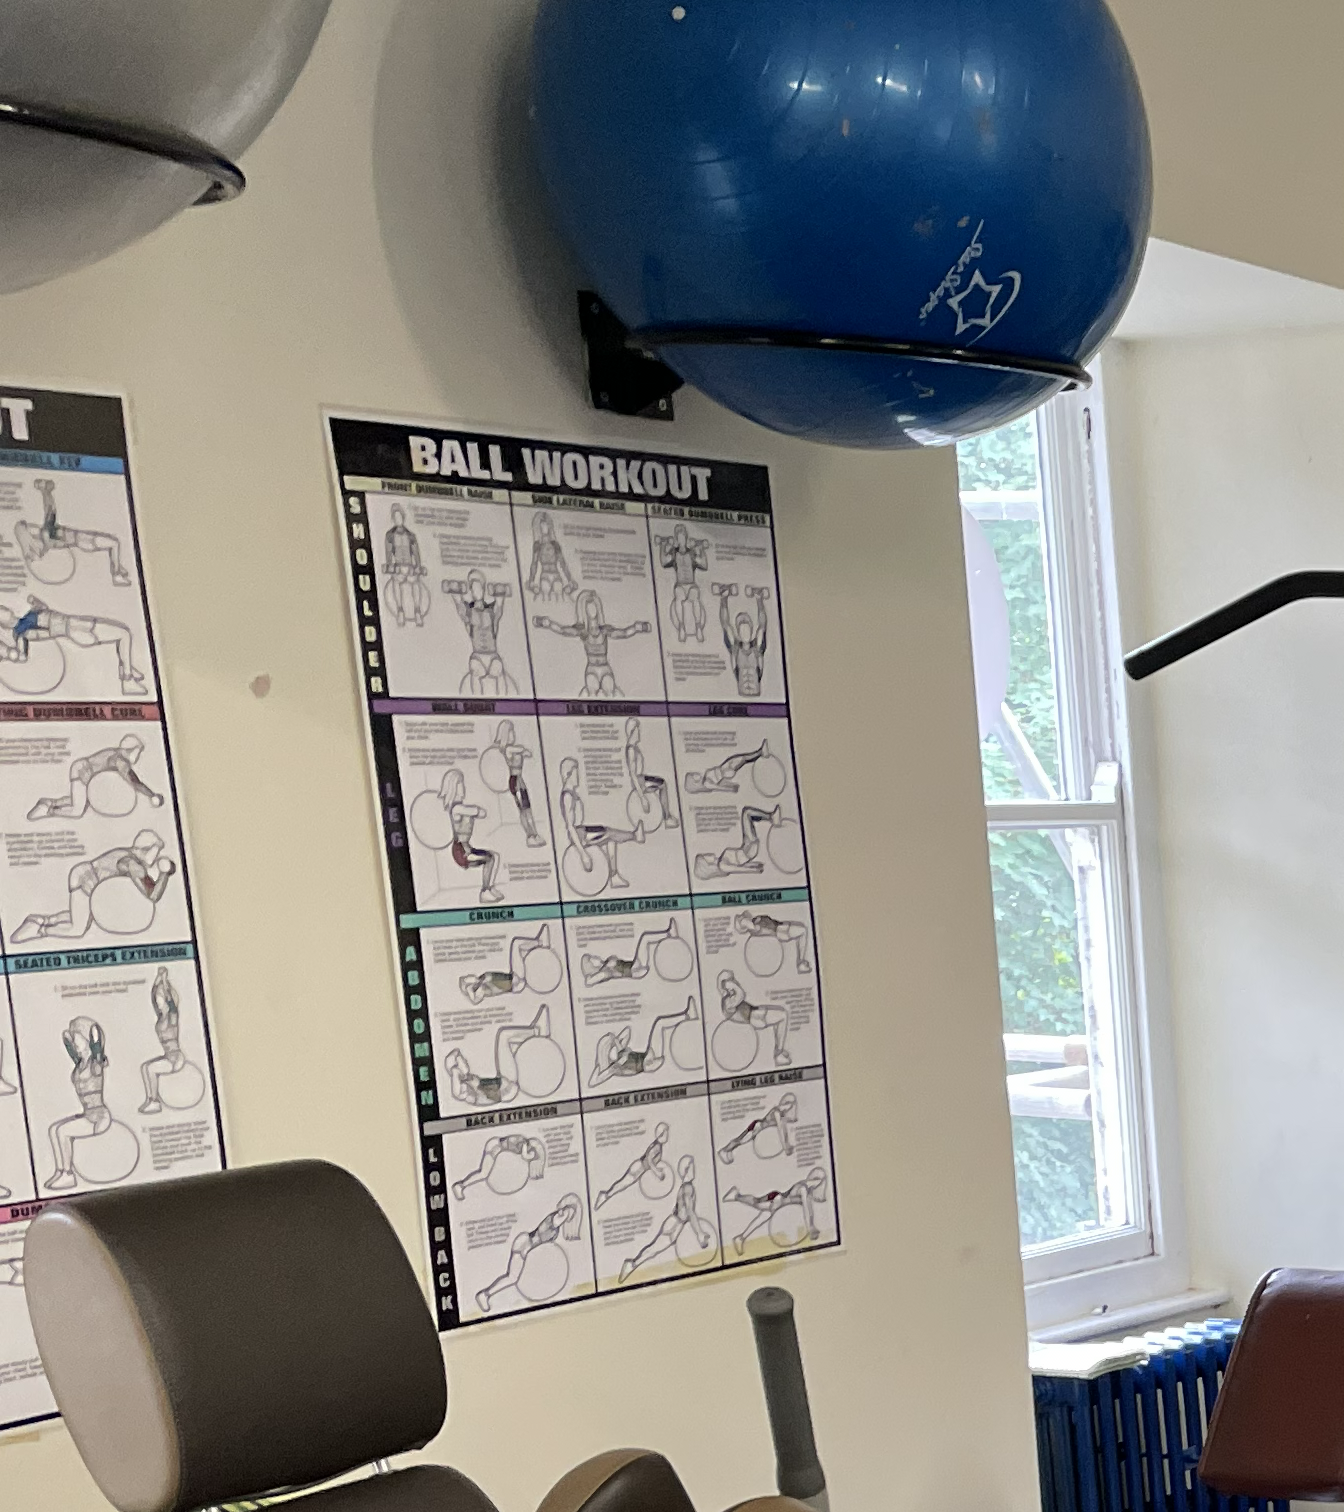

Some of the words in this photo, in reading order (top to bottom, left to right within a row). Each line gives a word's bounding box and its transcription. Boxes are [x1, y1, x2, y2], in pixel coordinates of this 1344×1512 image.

[408, 435, 513, 483] BALL
[522, 447, 712, 501] WORKOUT
[651, 504, 685, 518] SEATED
[688, 508, 735, 522] DUMBBELL
[737, 513, 767, 525] PRESS
[348, 495, 384, 694] SHOULDER
[468, 909, 515, 922] CRUNCH
[575, 900, 637, 915] CROSSOVER
[638, 898, 679, 911] CRUNCH
[14, 955, 62, 970] SEATED
[65, 951, 118, 967] TRICEPS
[121, 946, 188, 964] EXTENSION
[604, 1095, 632, 1109] BACK
[633, 1087, 688, 1105] EXTENSION
[465, 1114, 496, 1128] BACK
[498, 1107, 559, 1124] EXTENSION
[434, 1226, 454, 1313] BACK
